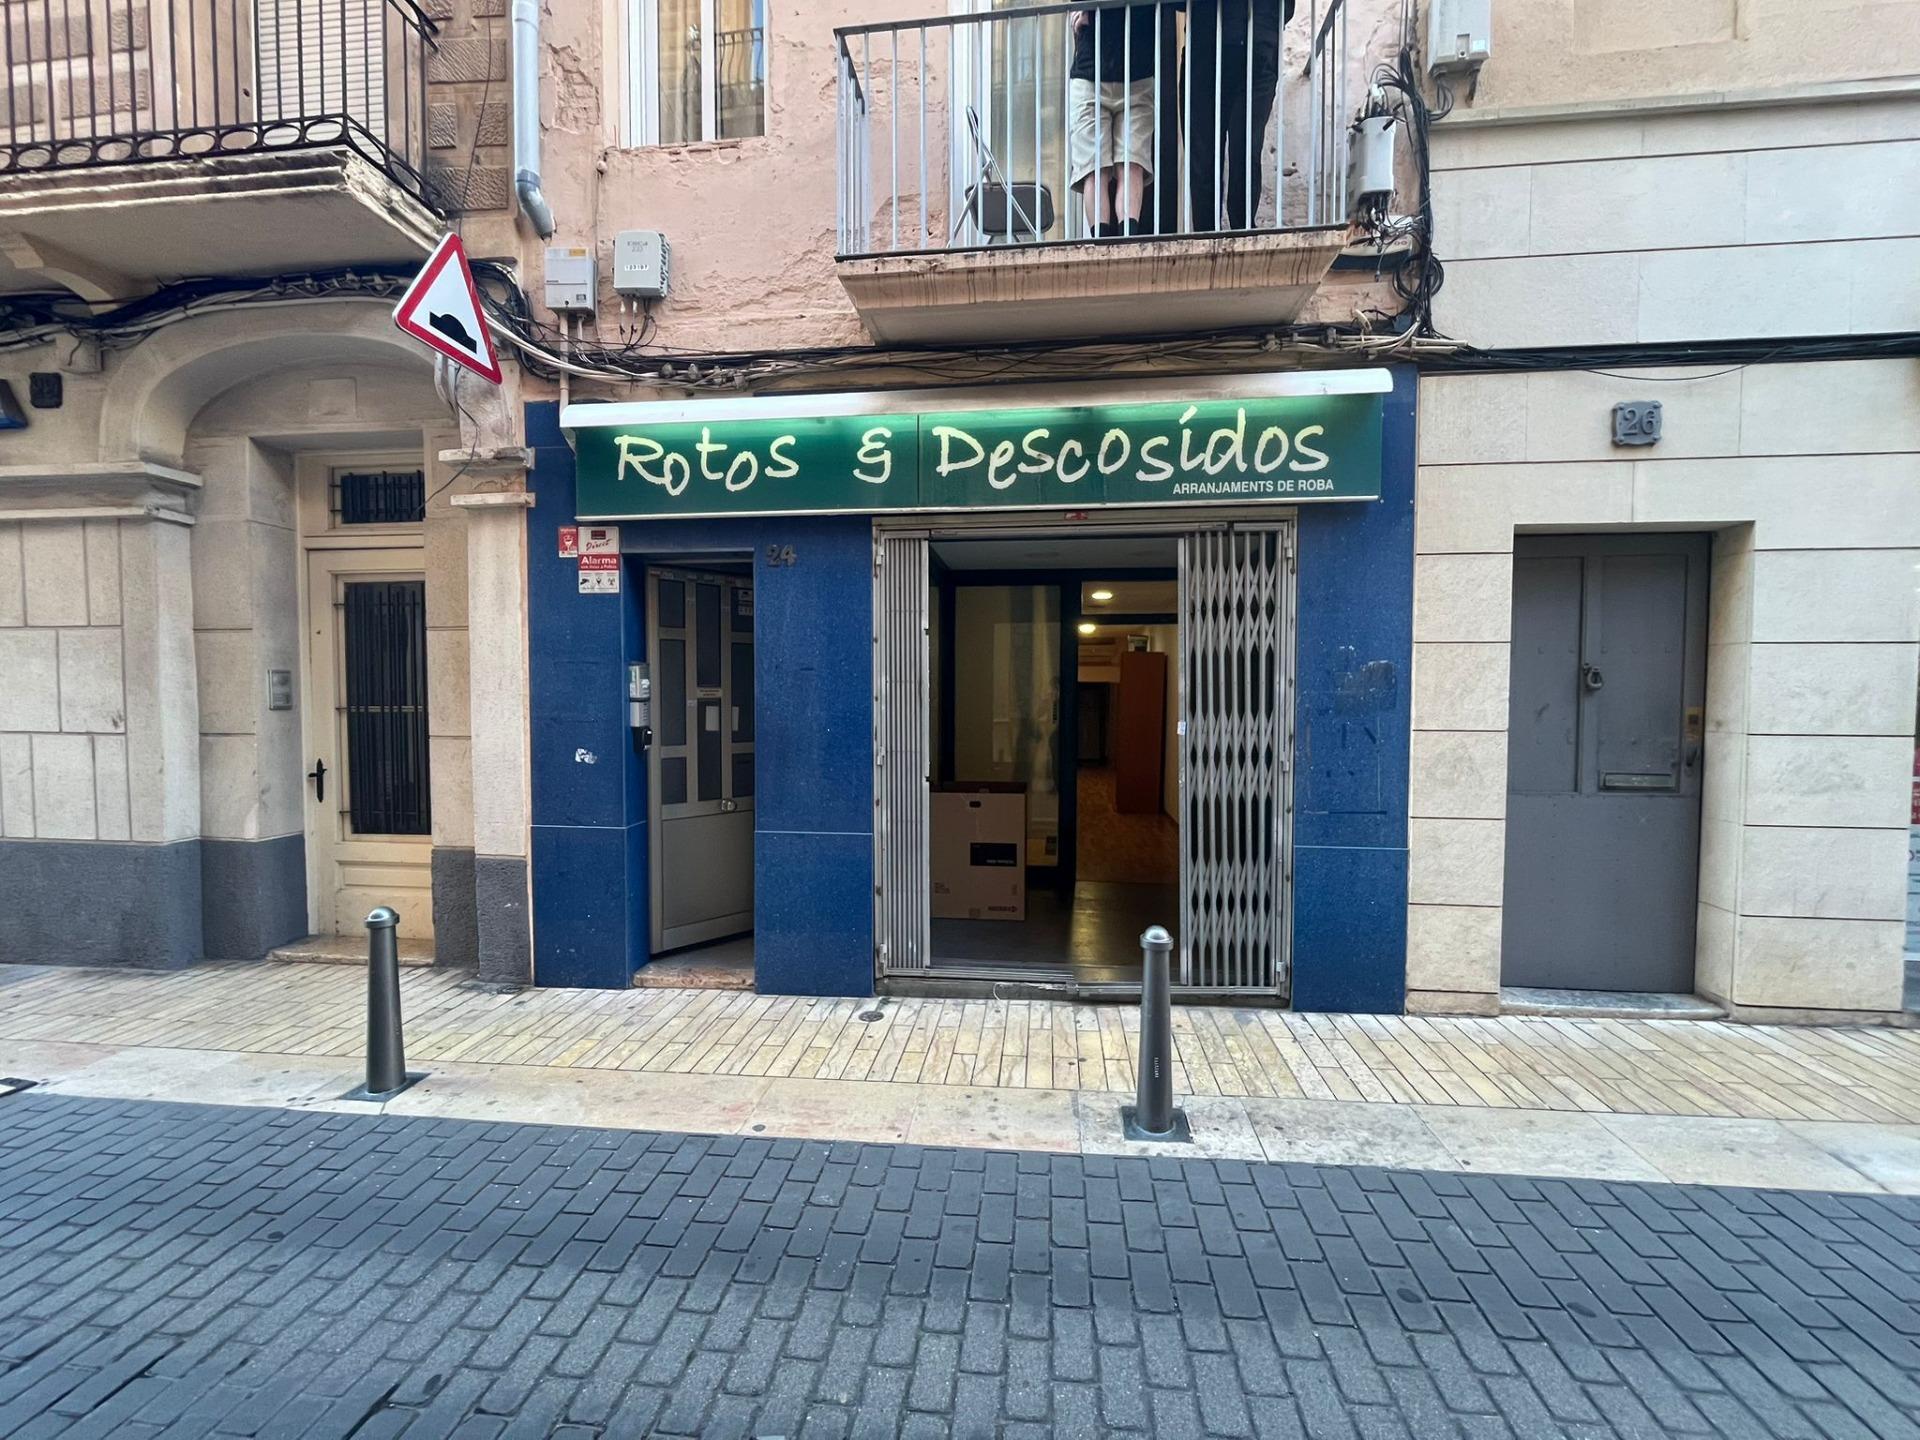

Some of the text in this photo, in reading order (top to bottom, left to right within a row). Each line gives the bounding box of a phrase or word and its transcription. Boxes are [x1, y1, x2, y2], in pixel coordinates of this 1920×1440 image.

[1622, 407, 1656, 437] 26
[613, 403, 1331, 497] Rotos & Descosídos
[1172, 478, 1334, 495] ARRANJAMENTS DE ROBA
[581, 555, 616, 564] Alarma
[766, 543, 798, 567] 24
